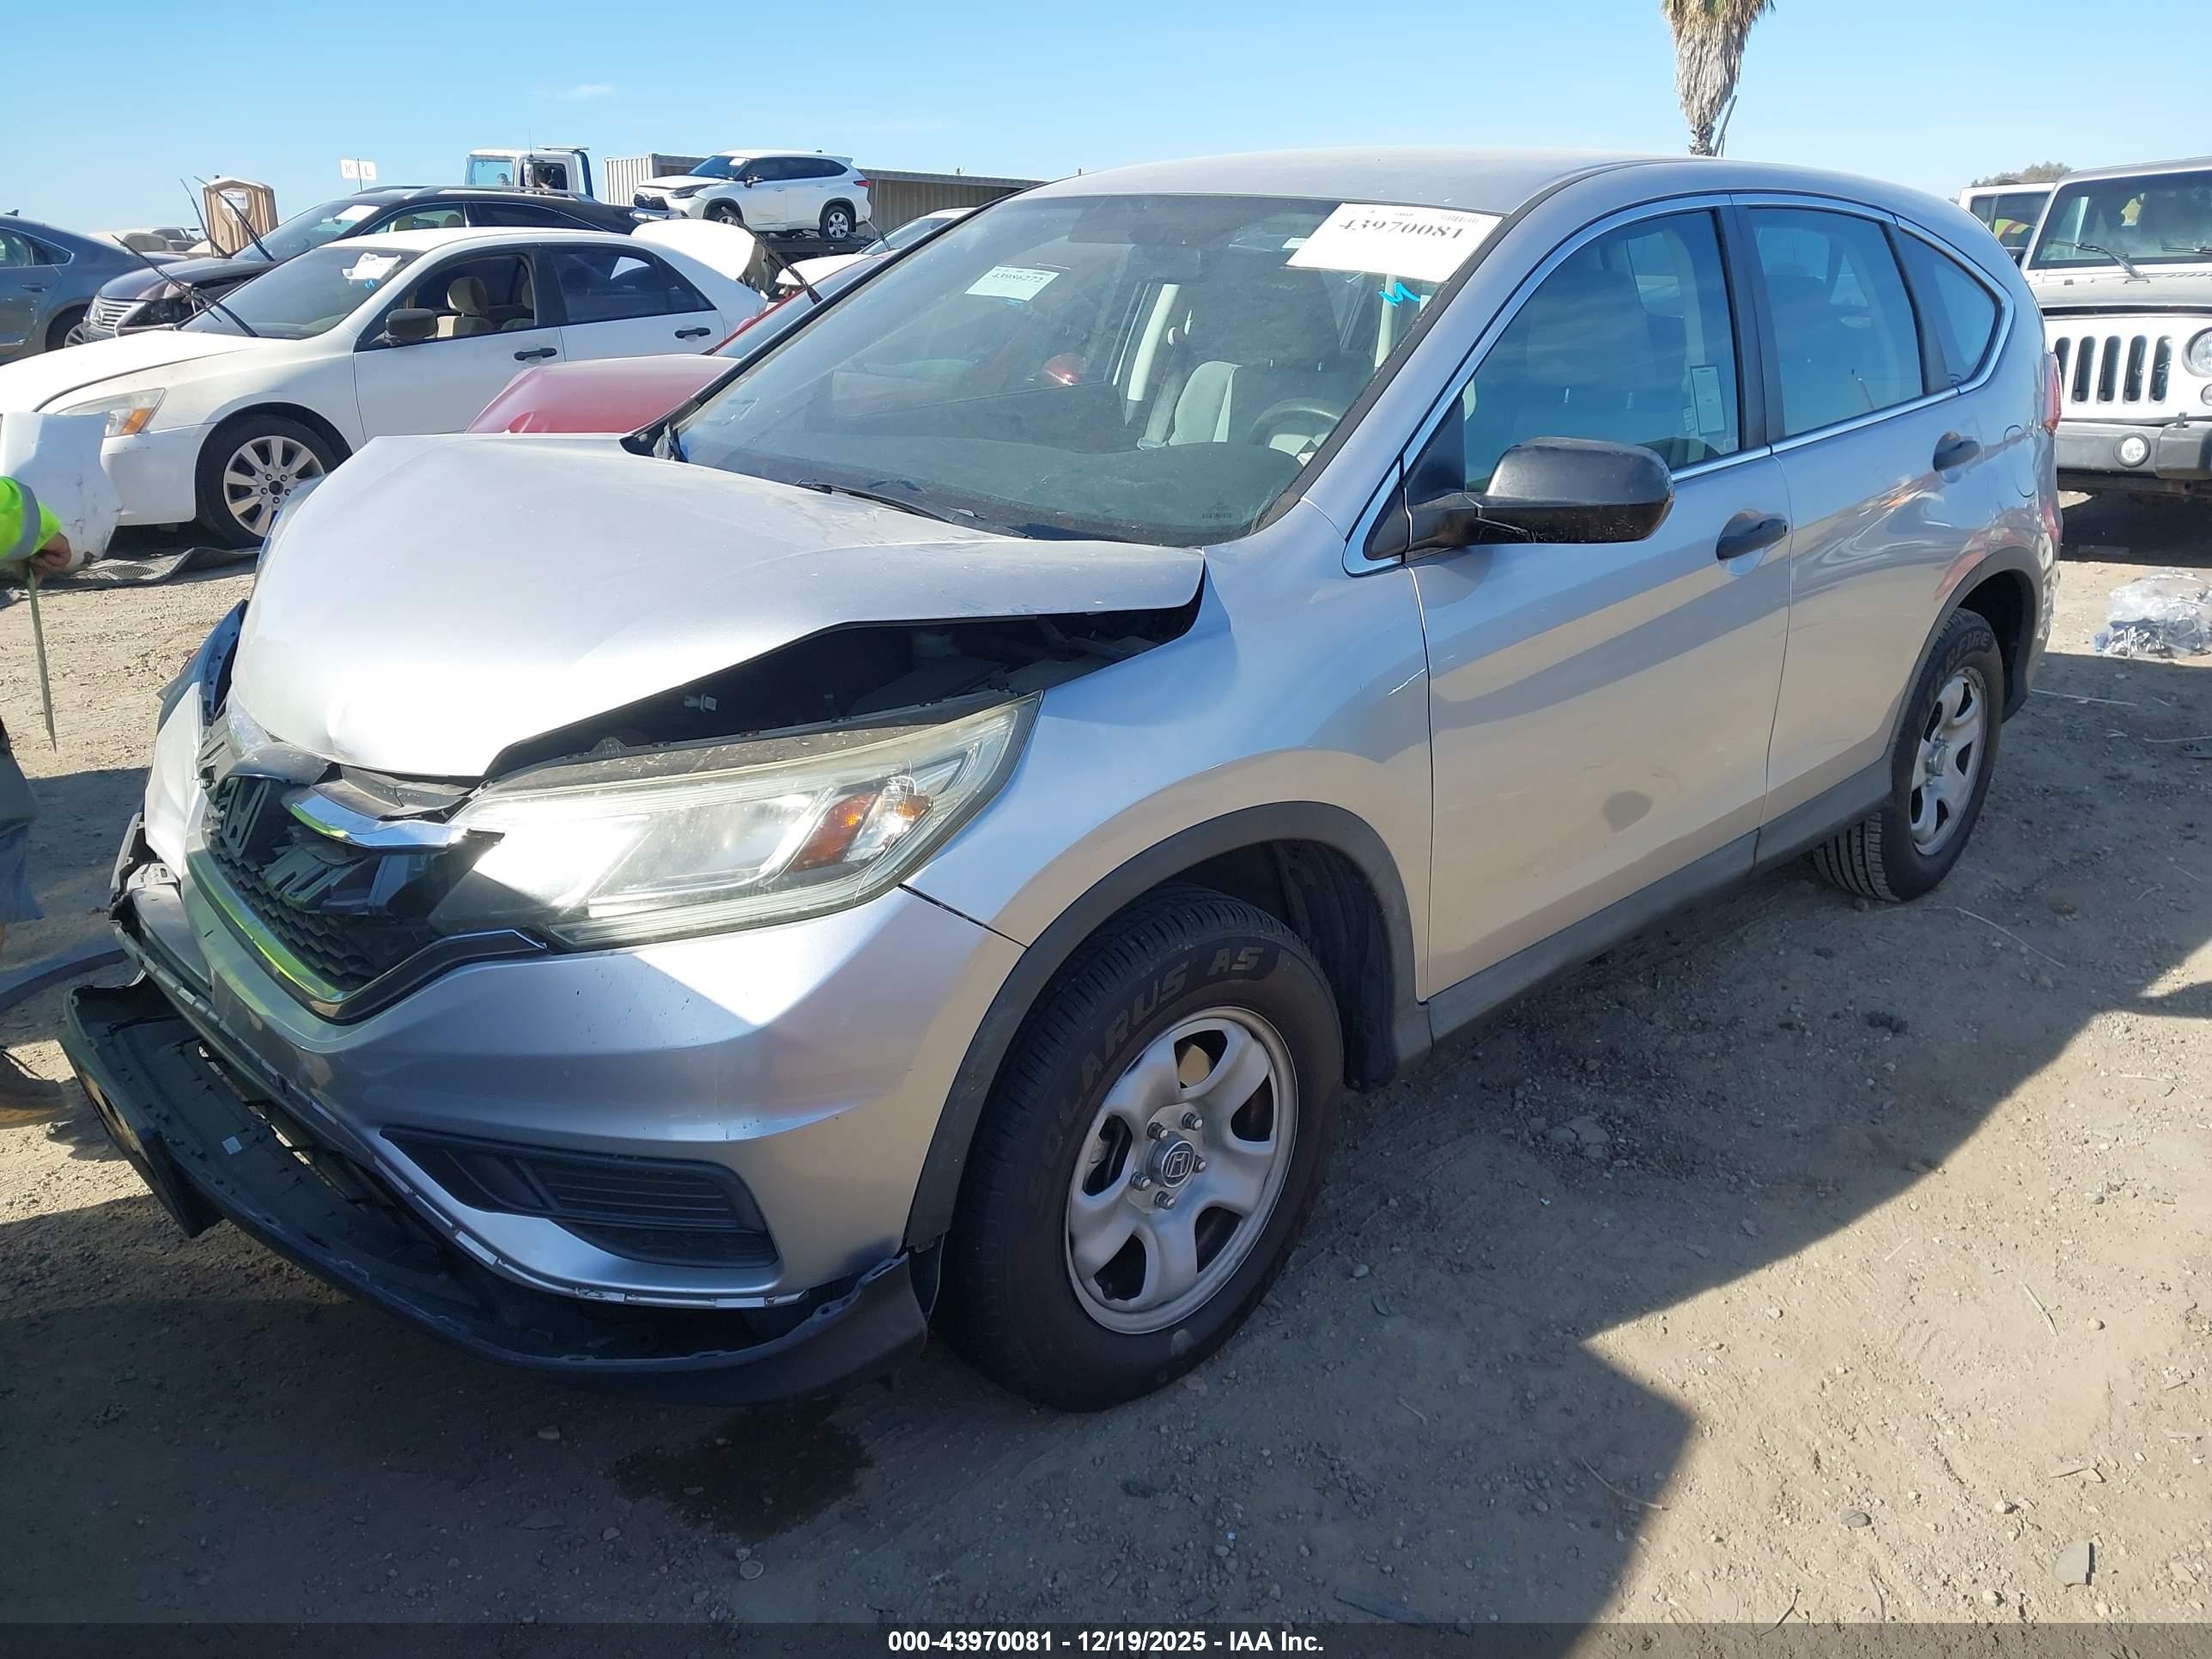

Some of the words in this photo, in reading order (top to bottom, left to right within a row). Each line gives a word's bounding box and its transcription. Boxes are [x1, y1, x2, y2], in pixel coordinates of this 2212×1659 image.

[364, 164, 373, 177] L
[1340, 219, 1464, 239] 43970081
[1206, 946, 1264, 975] AS
